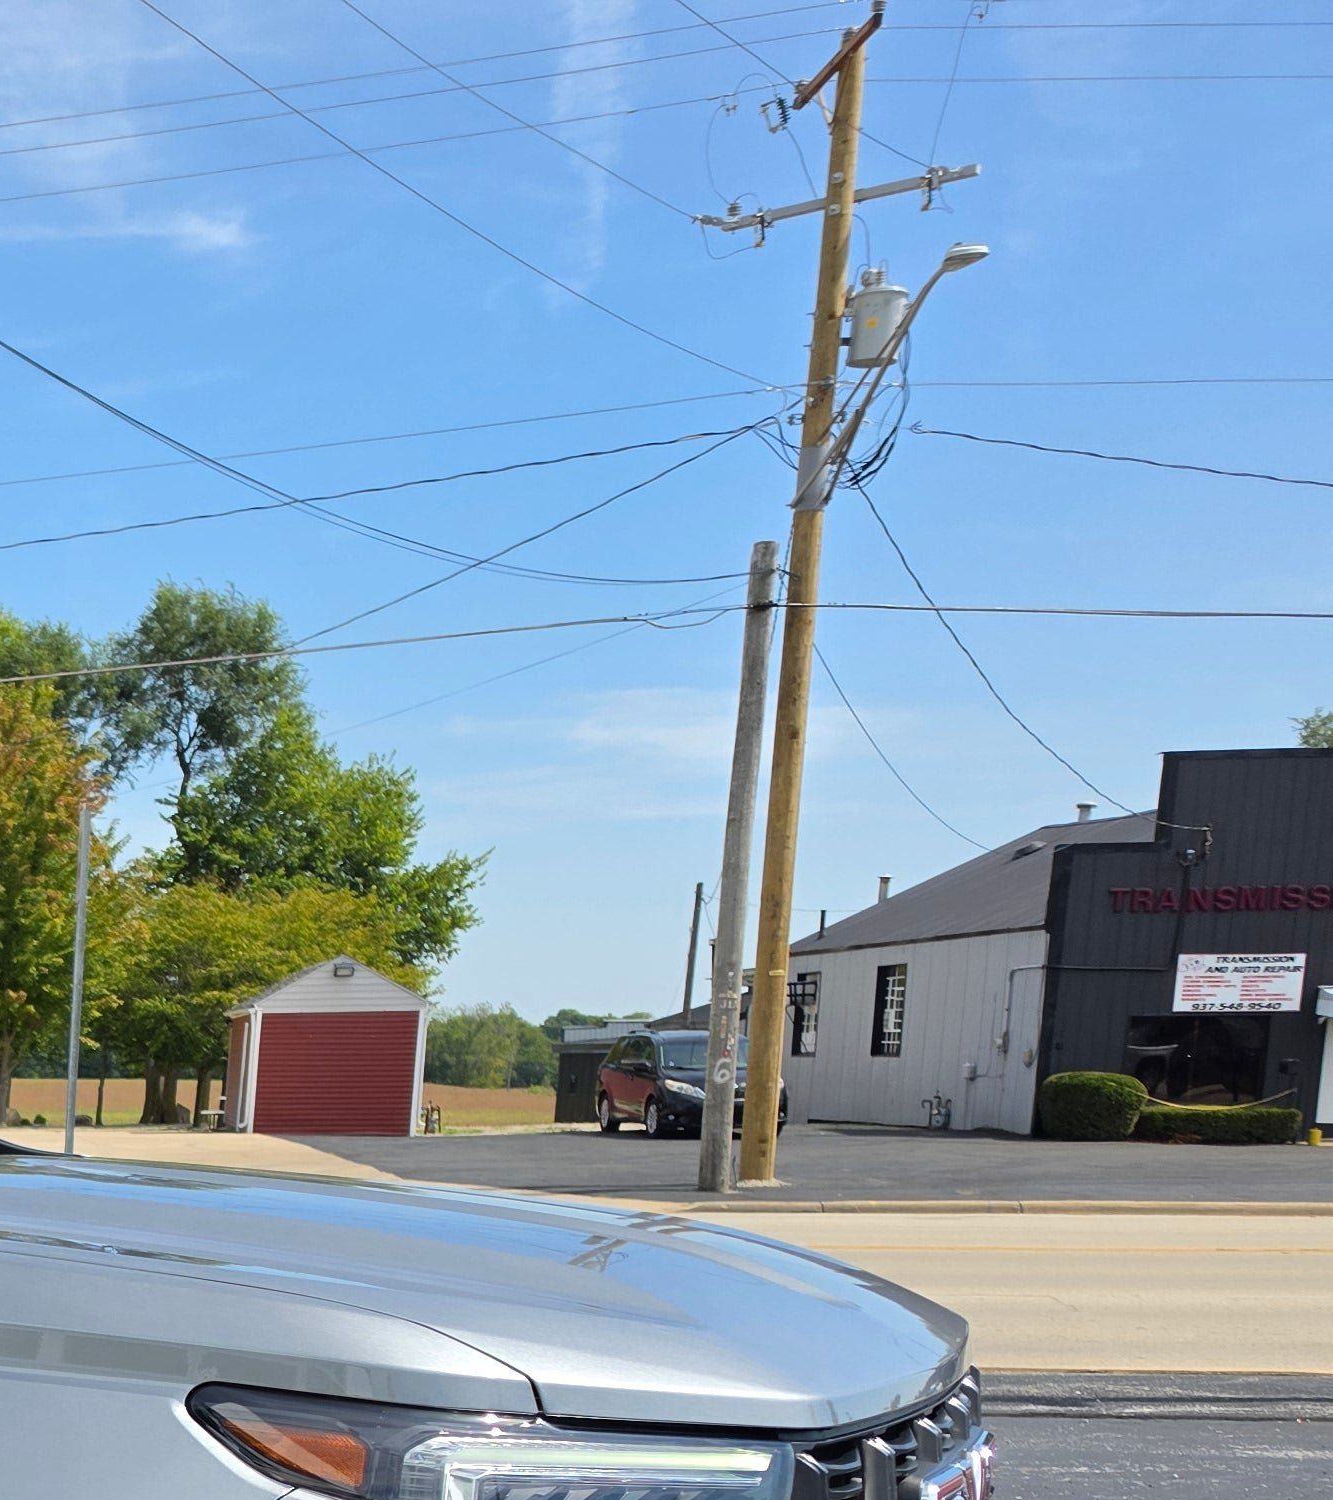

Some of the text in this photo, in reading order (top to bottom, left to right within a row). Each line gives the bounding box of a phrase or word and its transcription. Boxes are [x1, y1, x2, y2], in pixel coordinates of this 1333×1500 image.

[1109, 884, 1332, 914] TRANSMISS
[1263, 965, 1304, 973] REPAIR
[1191, 1003, 1282, 1011] 937-548-9540
